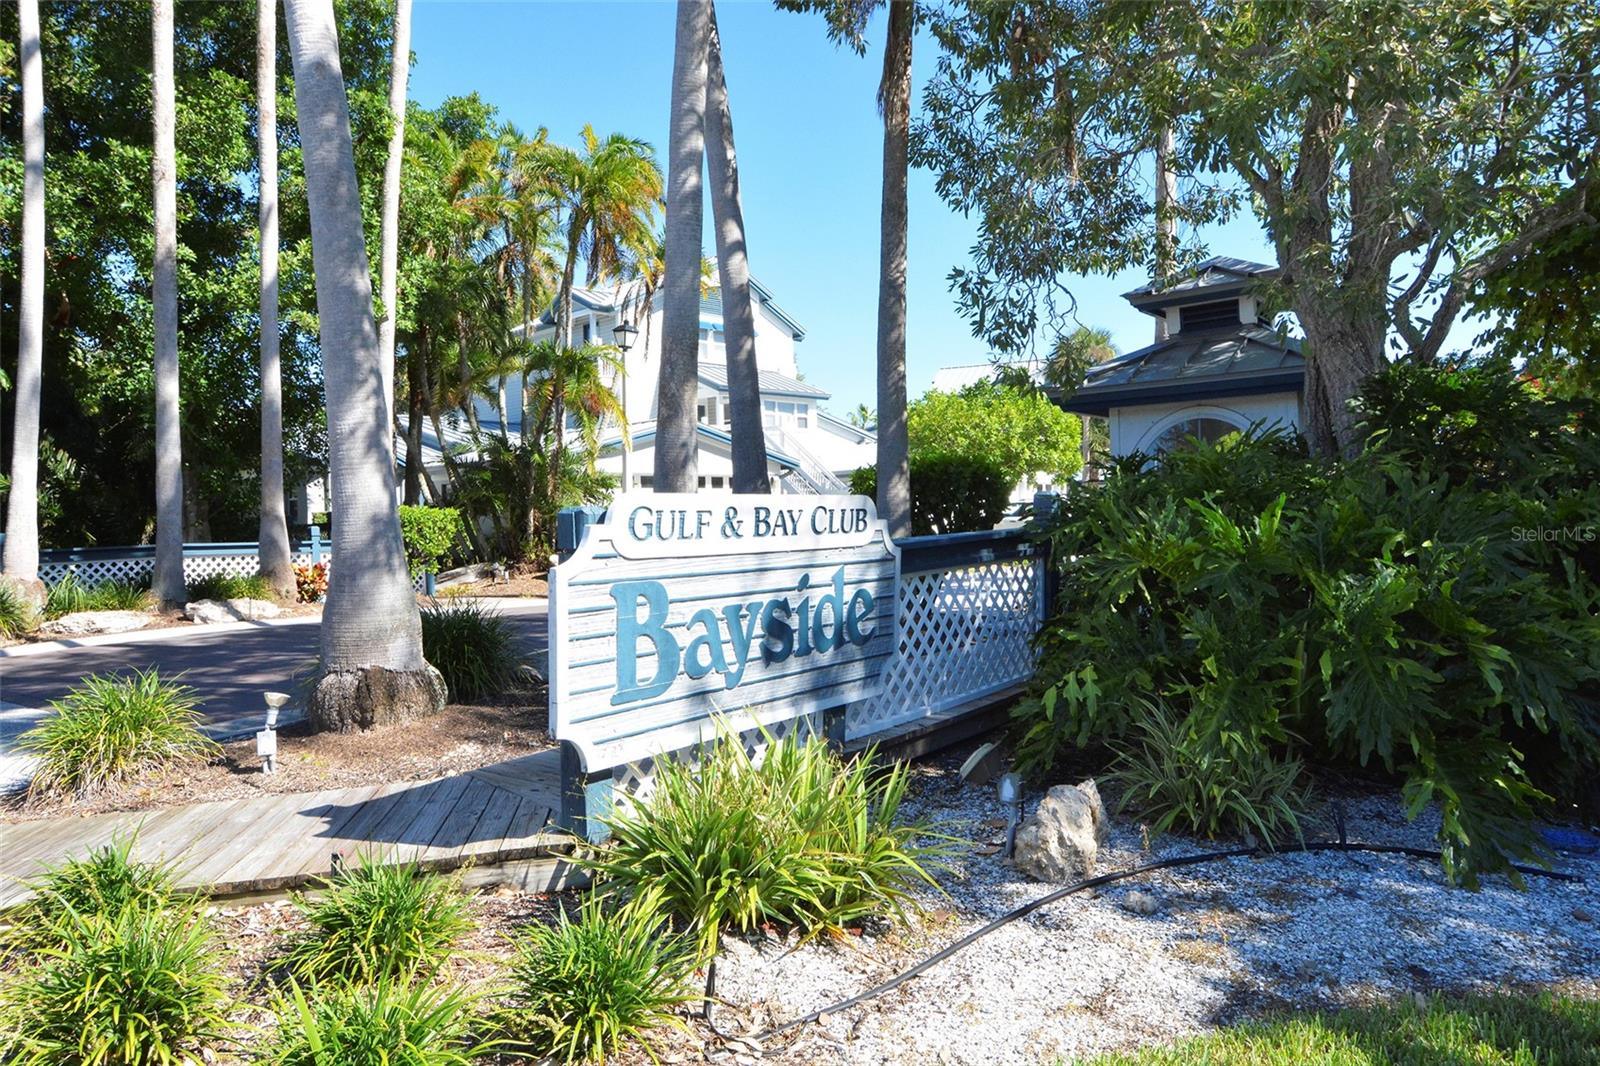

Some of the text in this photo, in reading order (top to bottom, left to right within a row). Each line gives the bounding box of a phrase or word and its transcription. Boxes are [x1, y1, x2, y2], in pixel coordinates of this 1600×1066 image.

[628, 505, 868, 541] GULF & BAY CLUB
[609, 565, 876, 706] Bayside
